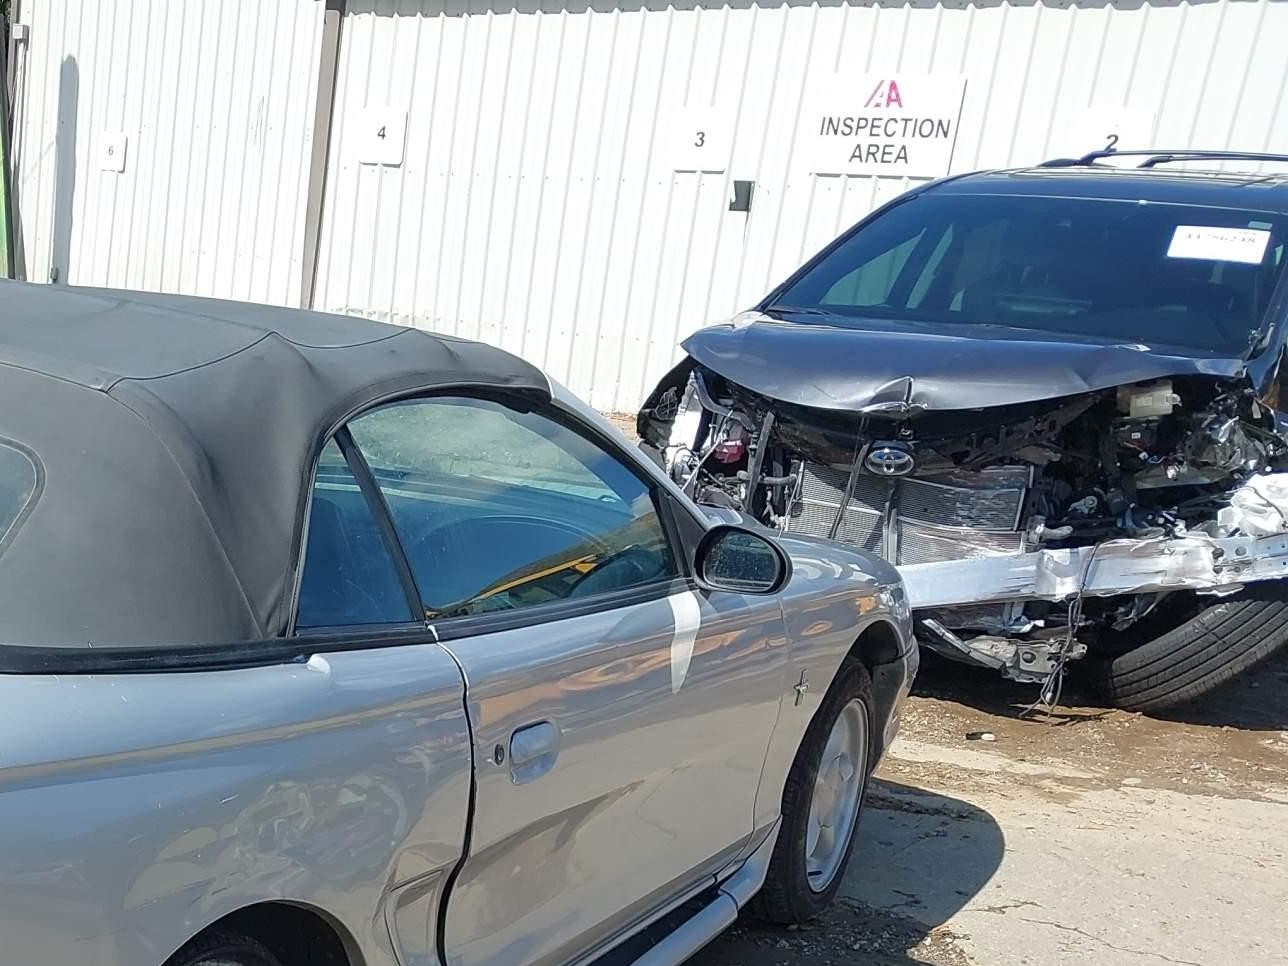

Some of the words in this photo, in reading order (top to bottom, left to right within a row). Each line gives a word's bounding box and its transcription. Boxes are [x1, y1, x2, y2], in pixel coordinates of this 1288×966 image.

[377, 125, 387, 140] 4
[819, 116, 952, 139] INSPECTION
[694, 131, 705, 148] 3
[1103, 134, 1119, 152] 2
[848, 143, 909, 165] AREA
